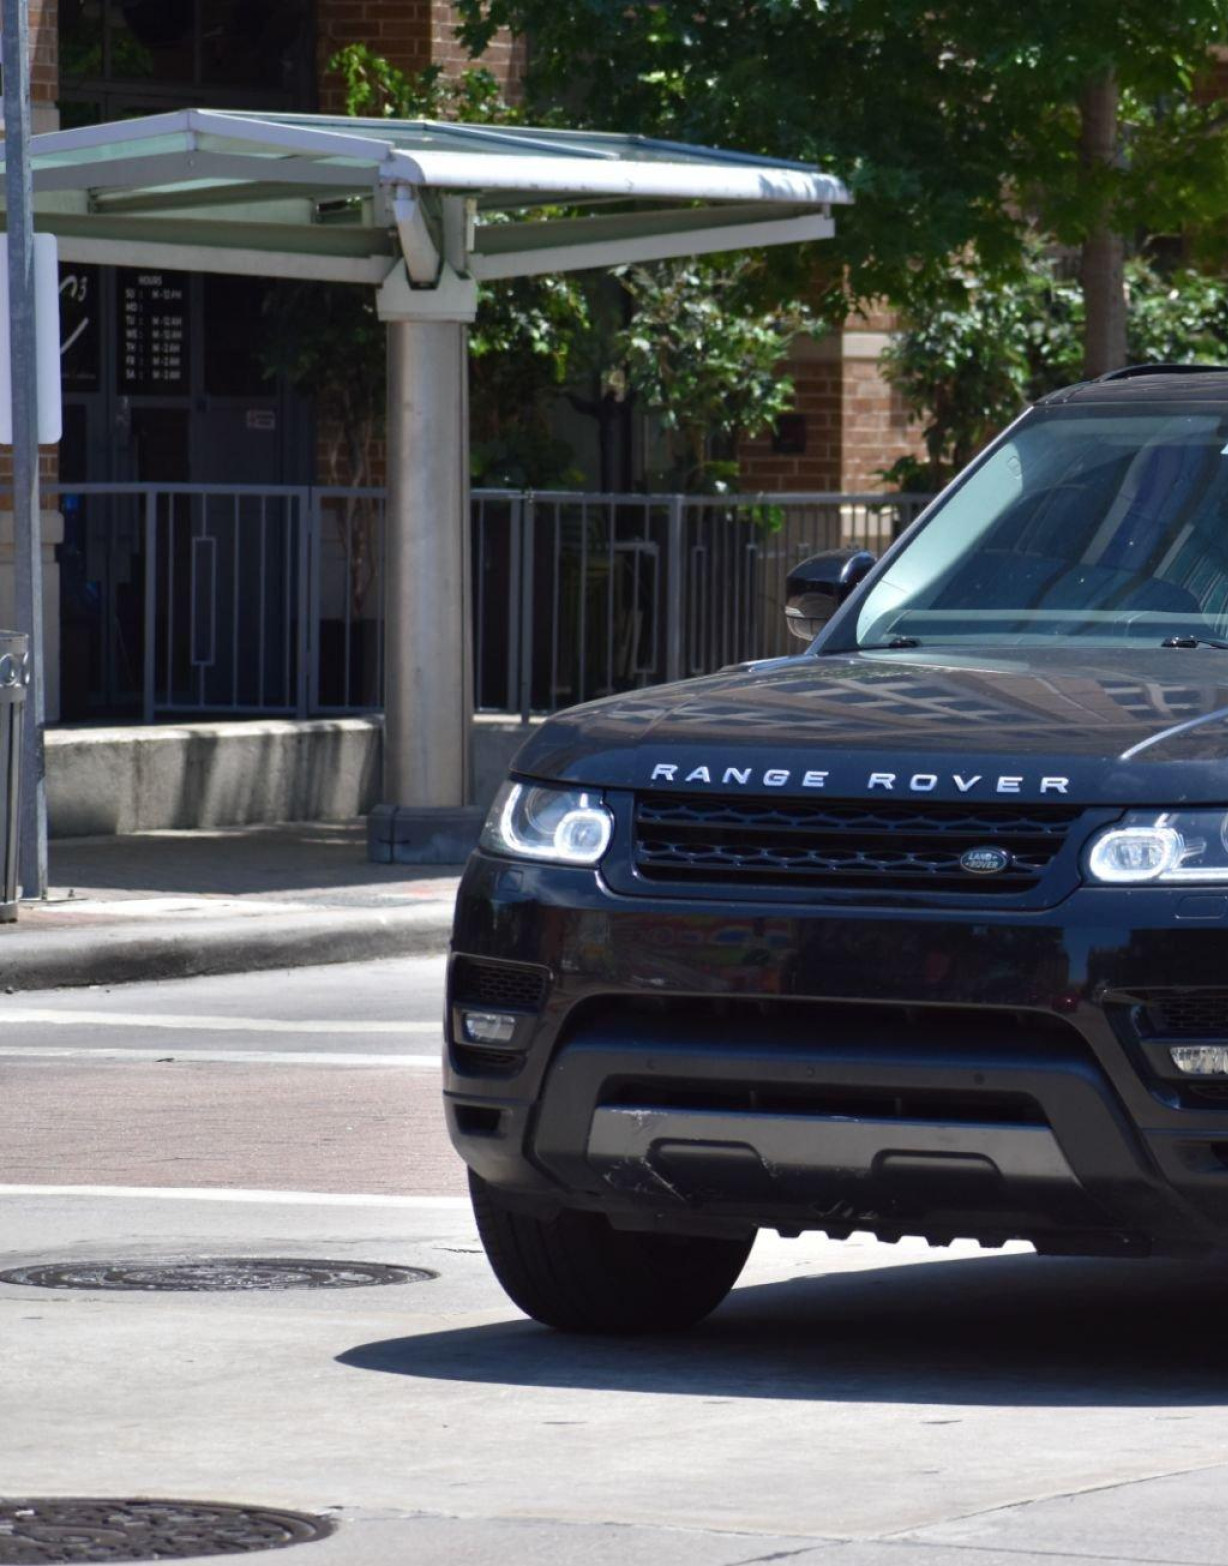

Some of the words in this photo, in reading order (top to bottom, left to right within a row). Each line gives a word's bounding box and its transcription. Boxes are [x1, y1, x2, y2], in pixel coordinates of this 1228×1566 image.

[138, 275, 162, 286] HOURS
[125, 302, 137, 312] MO
[125, 315, 135, 325] TU
[125, 355, 135, 365] FR
[125, 368, 135, 379] SA
[650, 763, 829, 788] RANGE
[867, 772, 1070, 795] ROVER
[968, 852, 992, 860] LAND
[970, 860, 999, 869] ROVER
